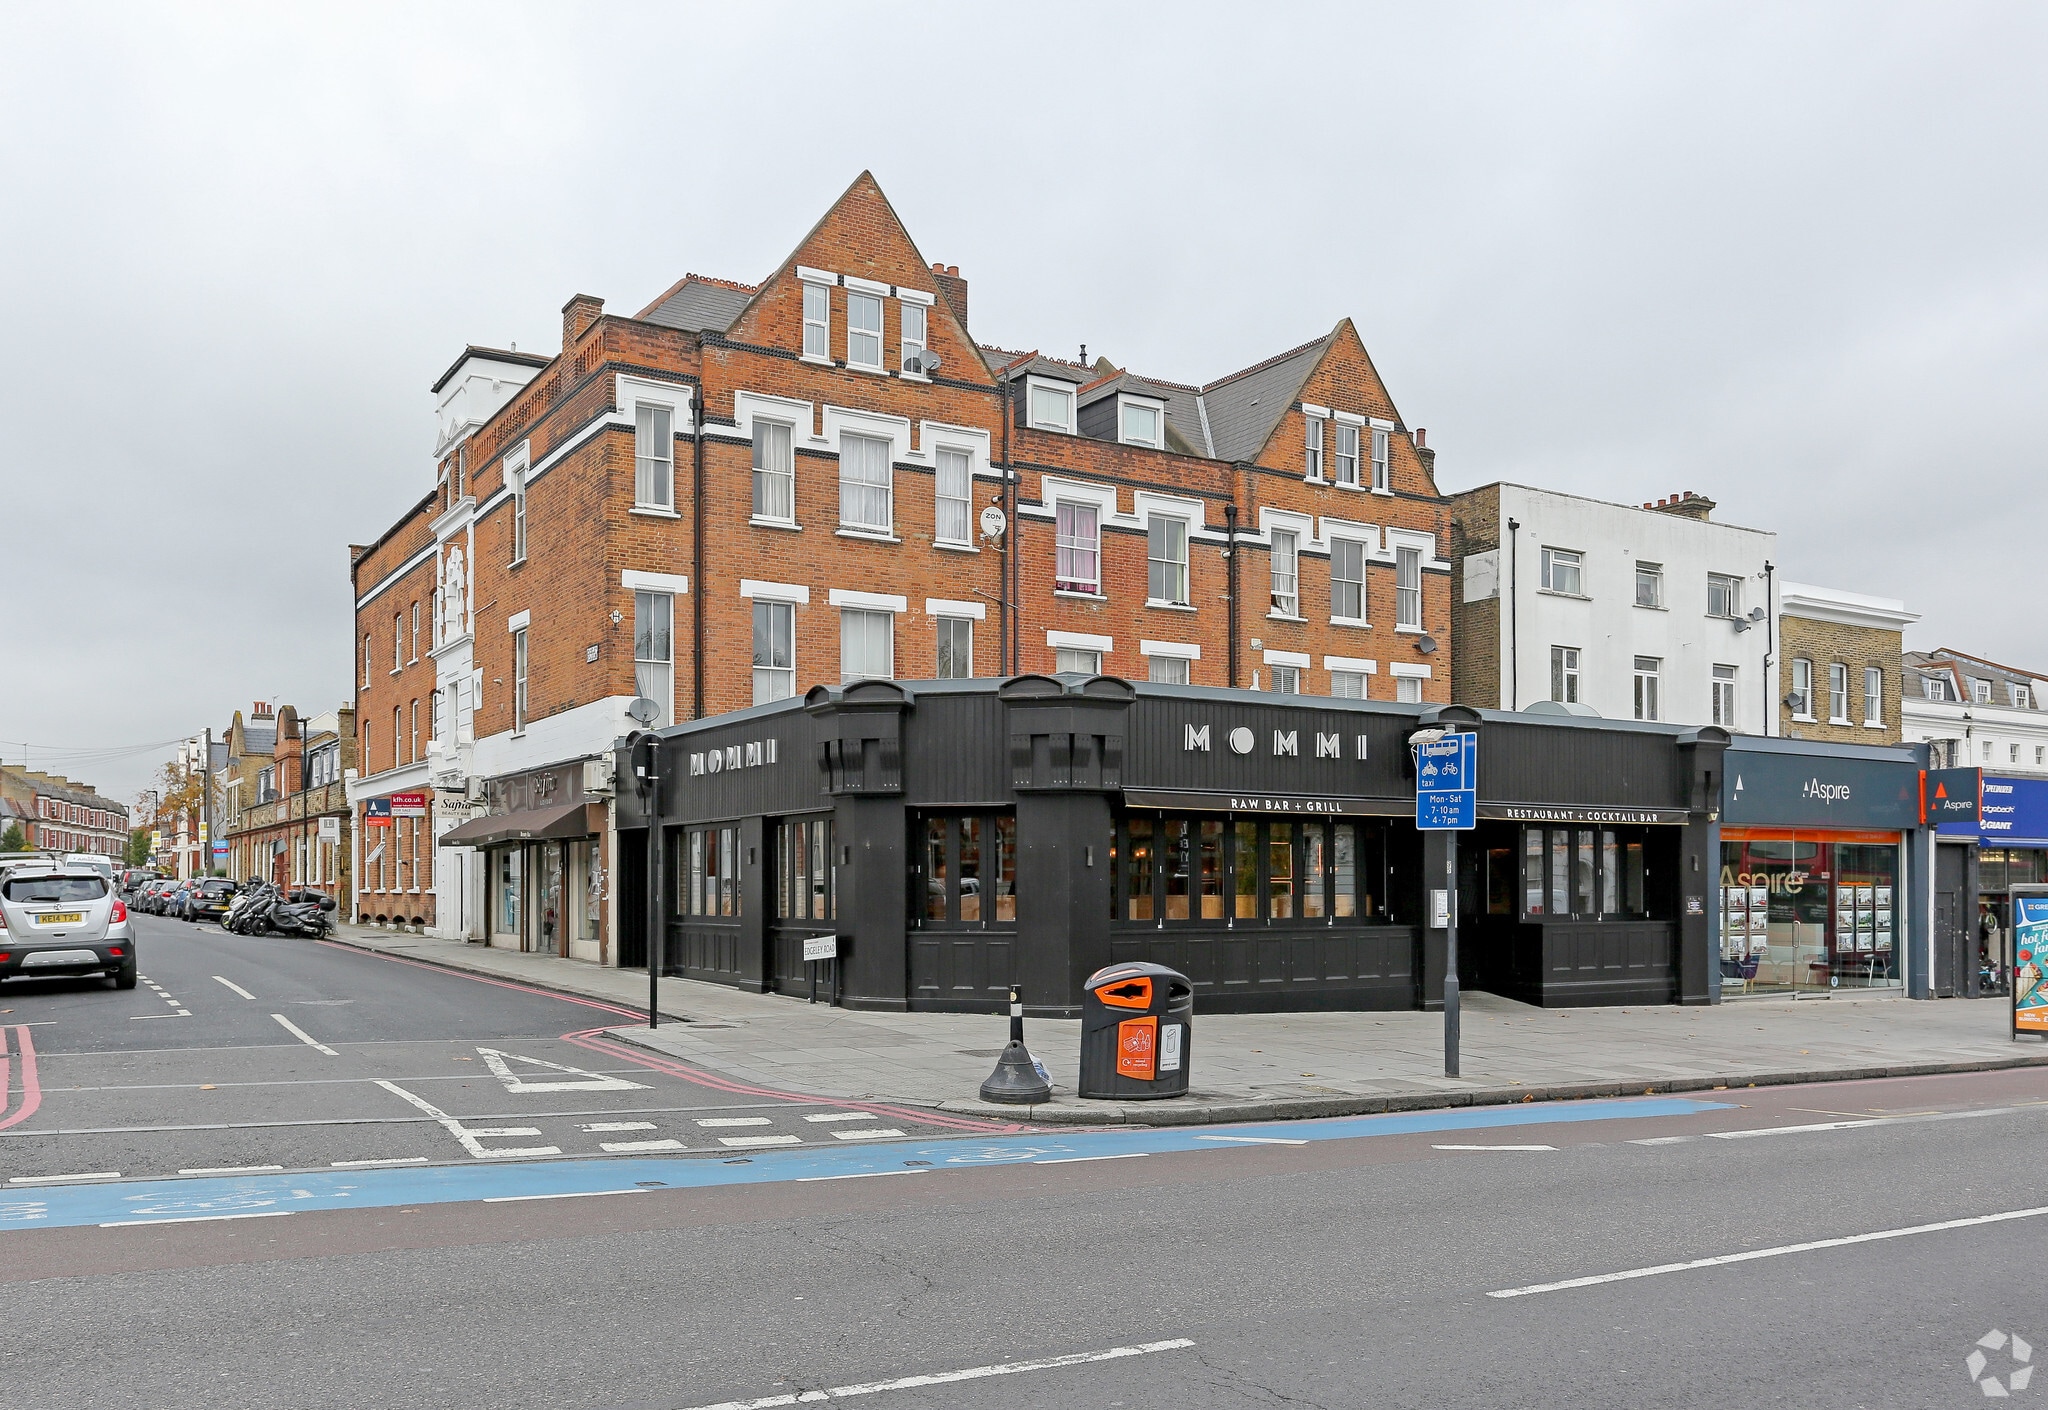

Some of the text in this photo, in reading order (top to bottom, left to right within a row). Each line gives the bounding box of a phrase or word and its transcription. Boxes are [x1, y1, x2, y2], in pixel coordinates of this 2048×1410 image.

[985, 512, 1001, 520] ZON
[1184, 723, 1368, 760] MOMMI
[690, 739, 777, 777] MOMMI
[1421, 779, 1434, 787] taxi
[1810, 778, 1850, 804] Aspire
[1429, 795, 1444, 803] Mon
[1449, 794, 1462, 803] Sat
[1231, 798, 1343, 812] RAW BAR + GRILL
[1943, 800, 1973, 811] Aspire
[1982, 805, 2015, 814] dgeback
[1507, 808, 1573, 820] RESTAURANT
[1587, 812, 1637, 822] COCKTAIL
[1640, 813, 1659, 823] BAR
[1986, 822, 2013, 830] GIANT
[1720, 865, 1804, 894] Aspire
[42, 913, 81, 922] KE14 TXJ
[2021, 933, 2039, 945] hot
[805, 944, 835, 955] EDGELEY ROAD
